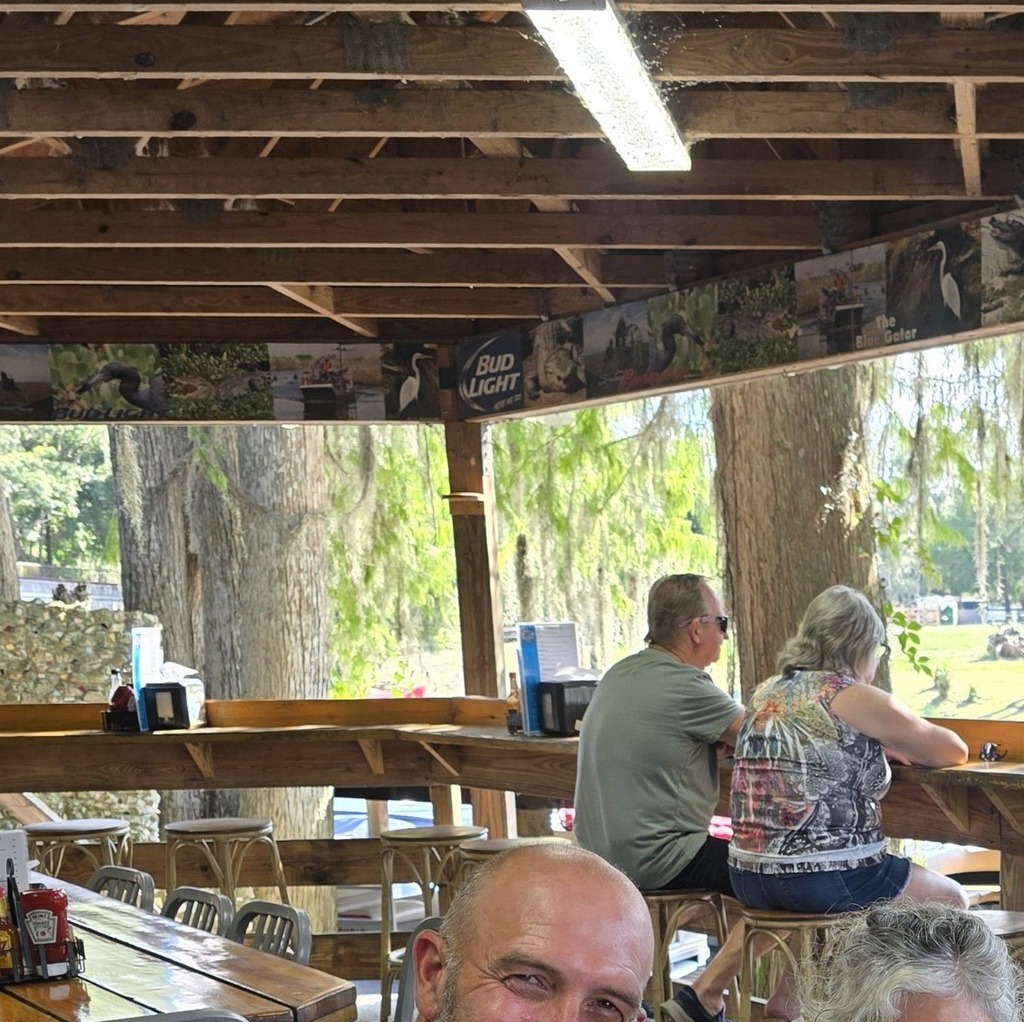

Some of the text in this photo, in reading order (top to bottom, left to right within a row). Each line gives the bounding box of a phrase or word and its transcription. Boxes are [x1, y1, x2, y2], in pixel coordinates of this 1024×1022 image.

[876, 314, 896, 328] The
[884, 328, 917, 344] Gator
[476, 353, 515, 376] BUD
[468, 372, 521, 398] LIGHT
